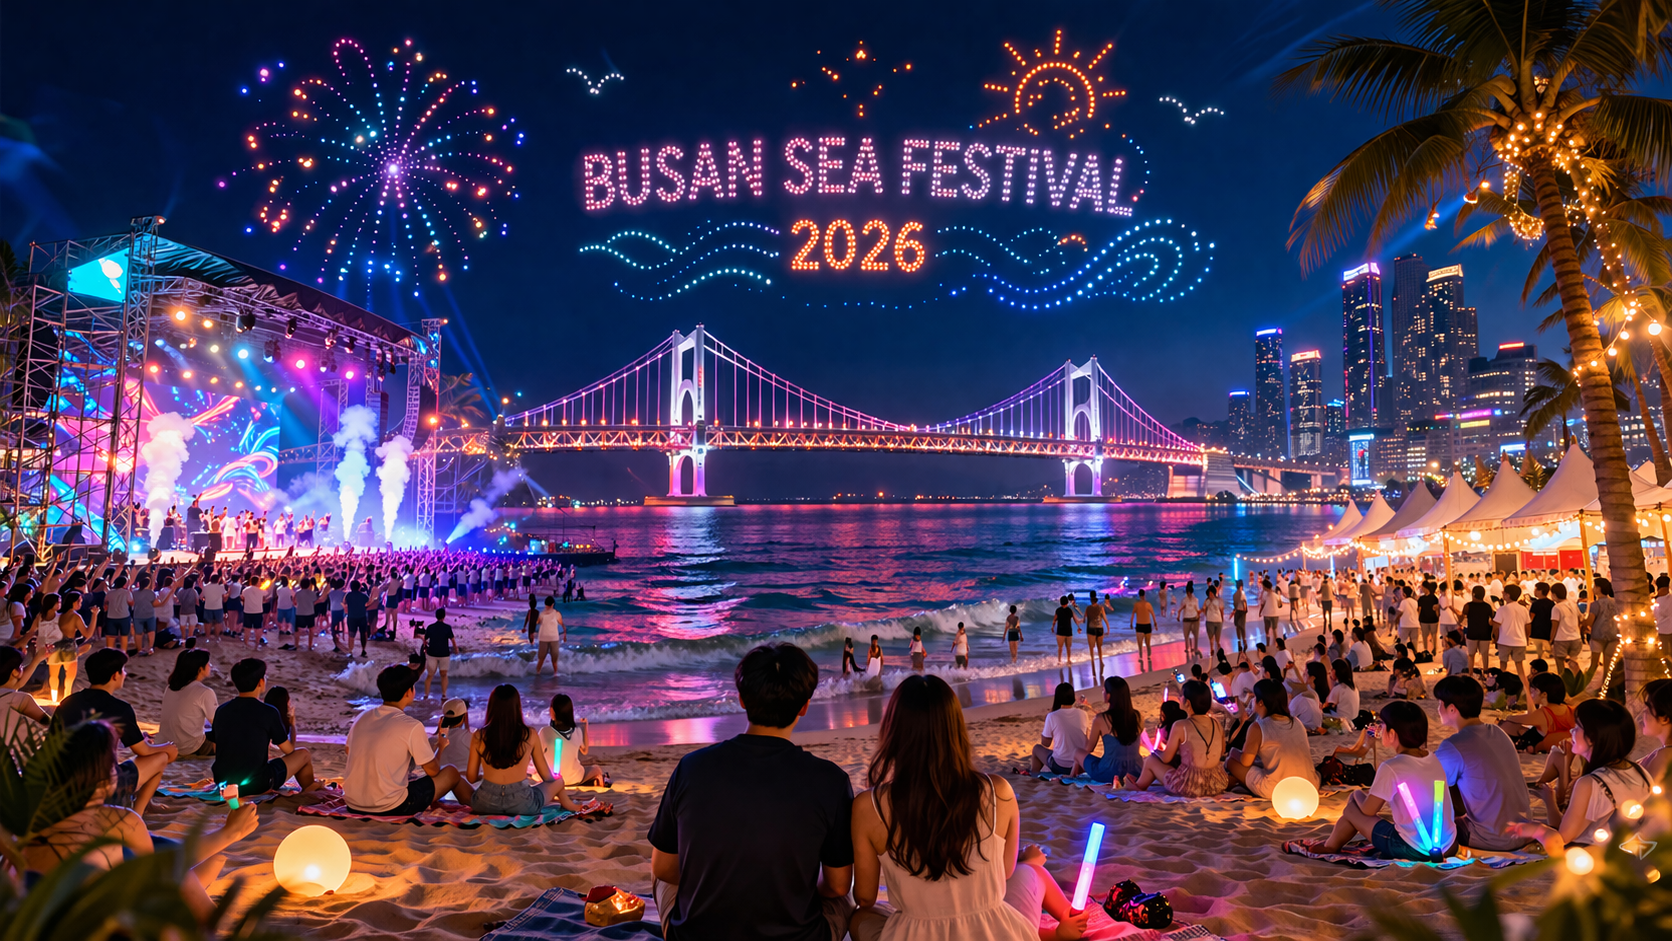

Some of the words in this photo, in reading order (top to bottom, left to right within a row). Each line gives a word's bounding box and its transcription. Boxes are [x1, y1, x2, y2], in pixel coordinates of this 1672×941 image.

[583, 139, 763, 211] BUSAN
[783, 137, 884, 195] SEA
[901, 139, 1134, 217] FESTIVAL
[790, 218, 926, 273] 2026
